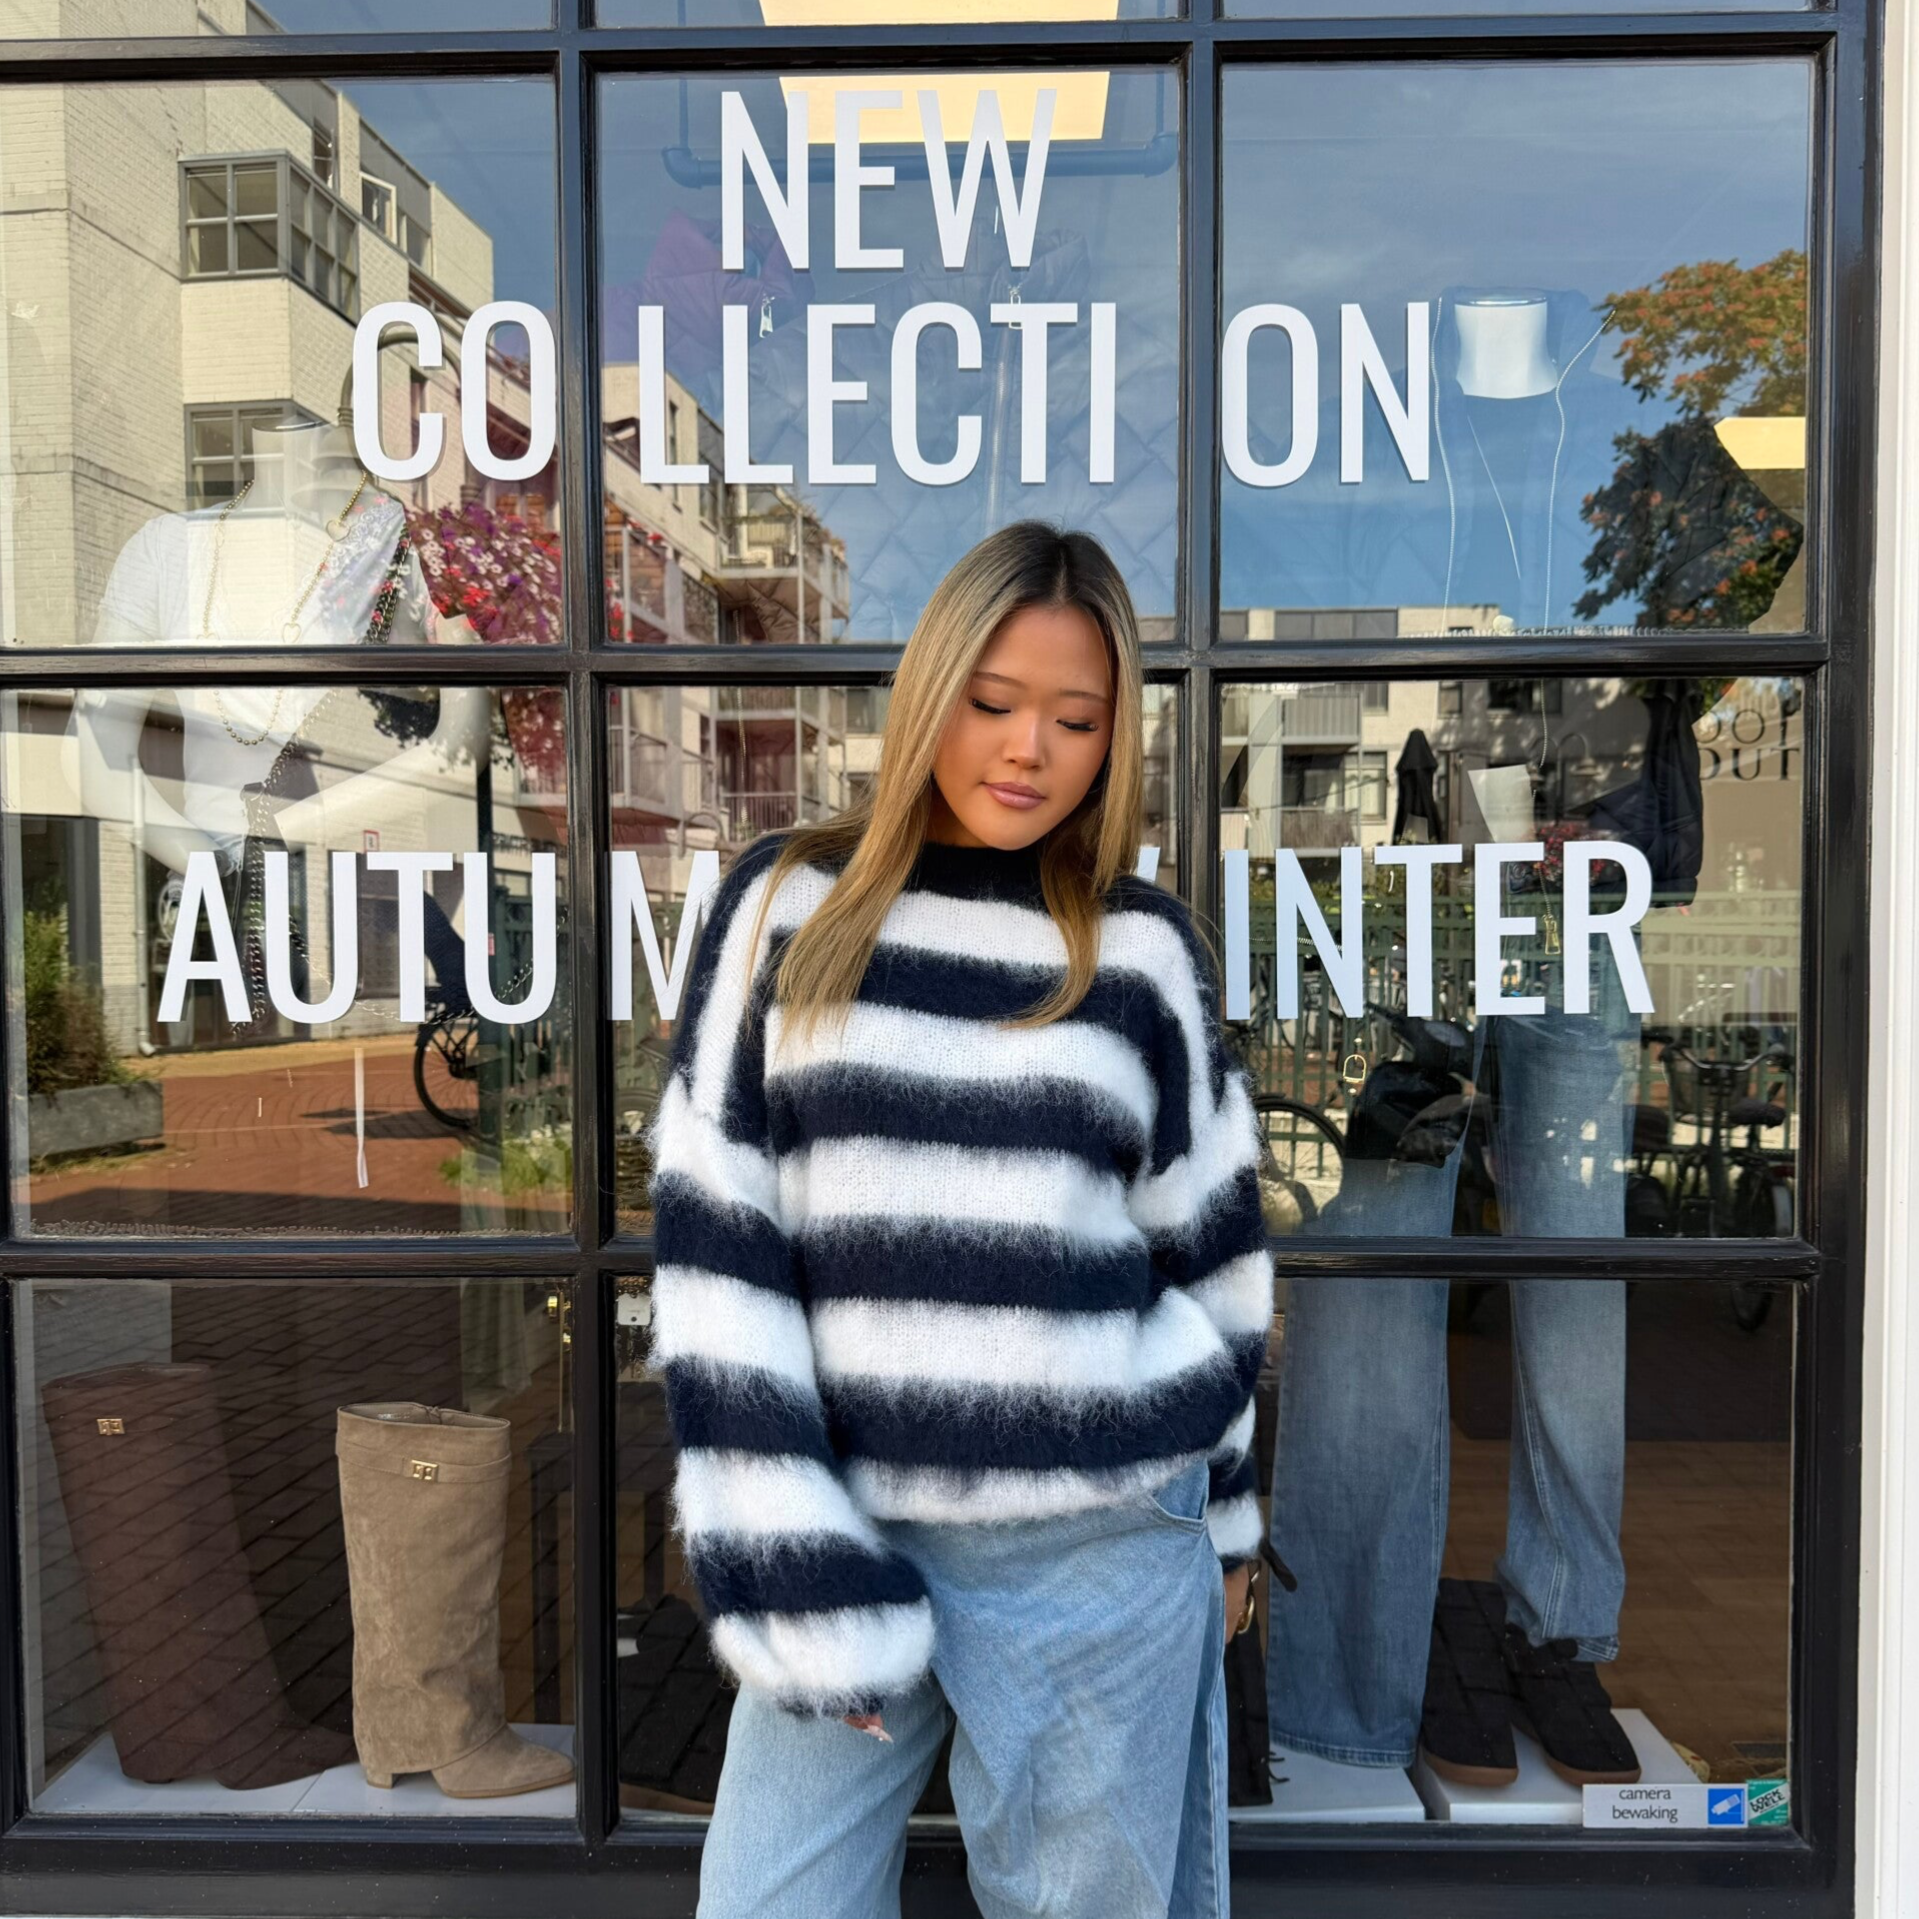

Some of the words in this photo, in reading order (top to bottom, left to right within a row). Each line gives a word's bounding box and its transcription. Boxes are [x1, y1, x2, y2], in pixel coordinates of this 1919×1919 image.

[722, 88, 1057, 270] NEW
[158, 850, 720, 1024] AUTUM
[1137, 841, 1655, 1020] INTER
[1612, 1805, 1678, 1823] bewaking
[1619, 1788, 1671, 1801] camera
